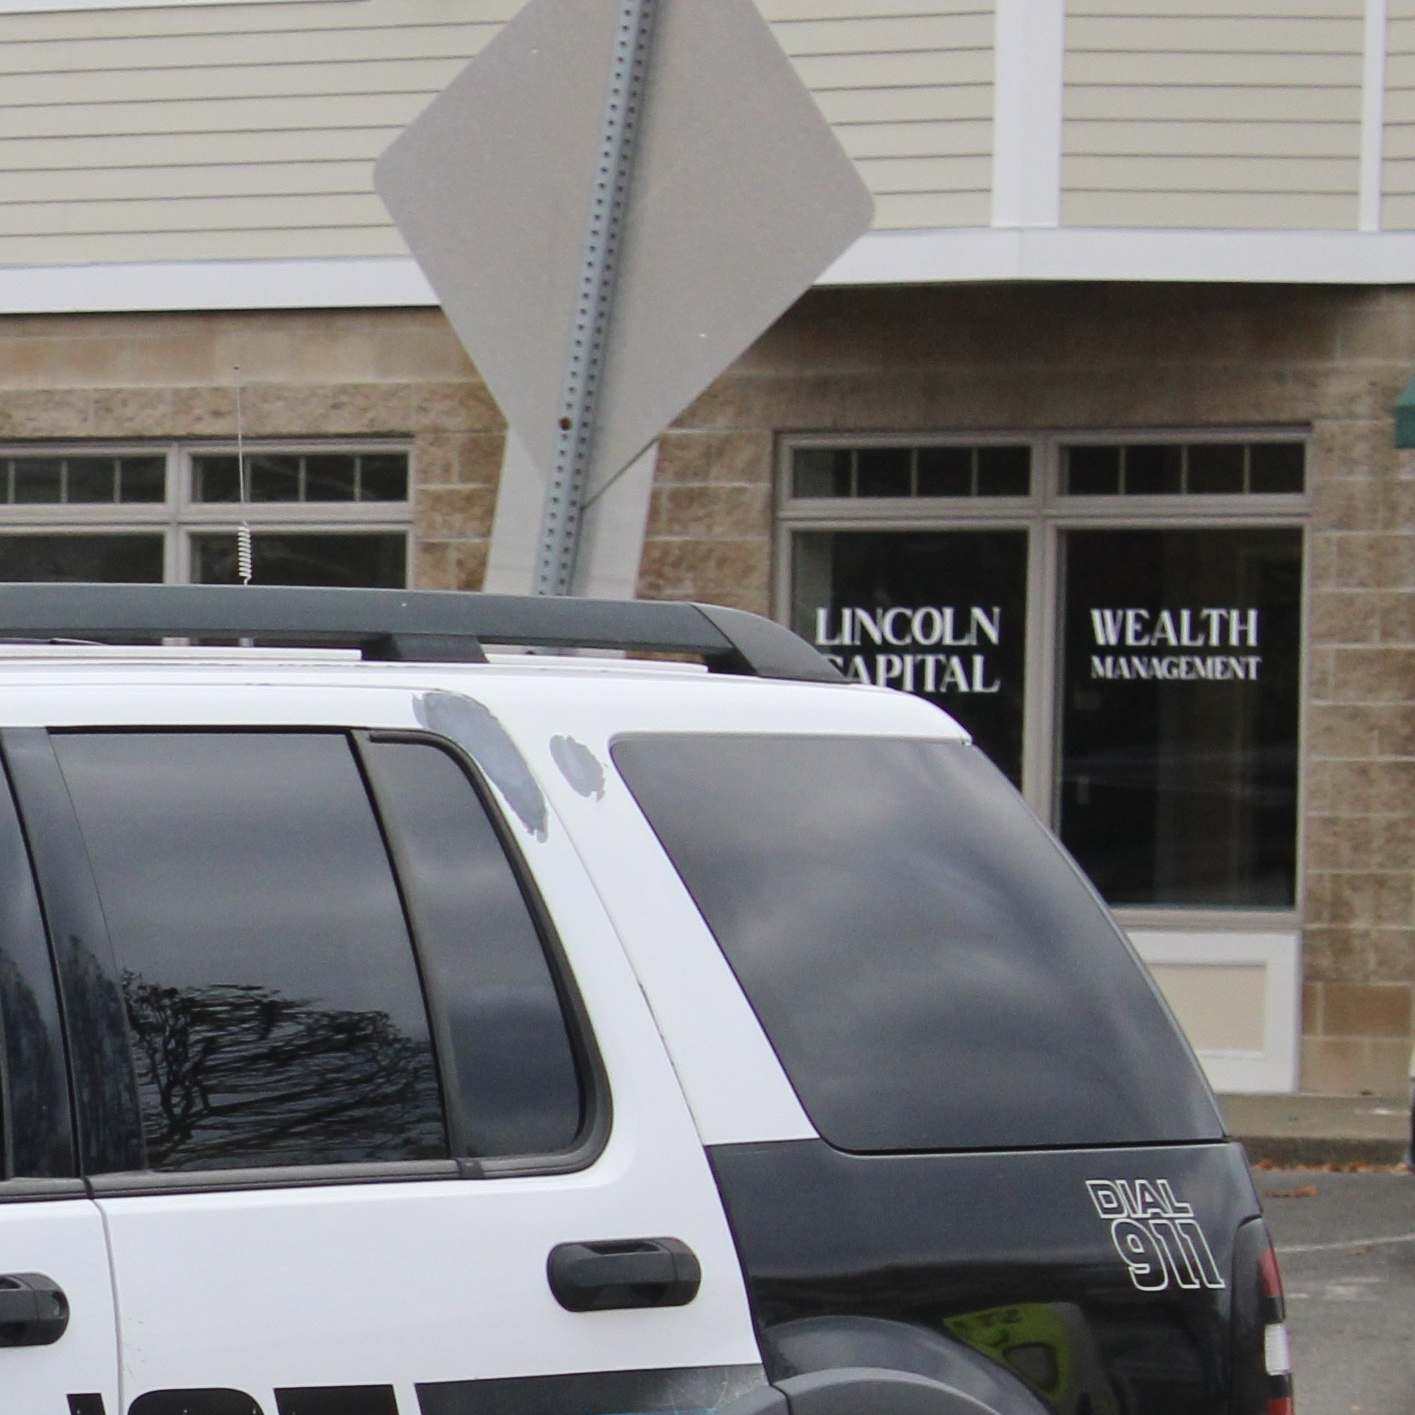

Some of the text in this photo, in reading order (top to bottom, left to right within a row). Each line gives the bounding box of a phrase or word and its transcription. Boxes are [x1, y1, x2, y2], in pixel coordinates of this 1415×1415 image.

[815, 606, 1001, 646] LINCOLN
[1090, 608, 1259, 647] WEALTH
[1091, 655, 1261, 680] MANAGEMENT
[1085, 1179, 1194, 1218] DIAL
[1111, 1218, 1226, 1291] 911
